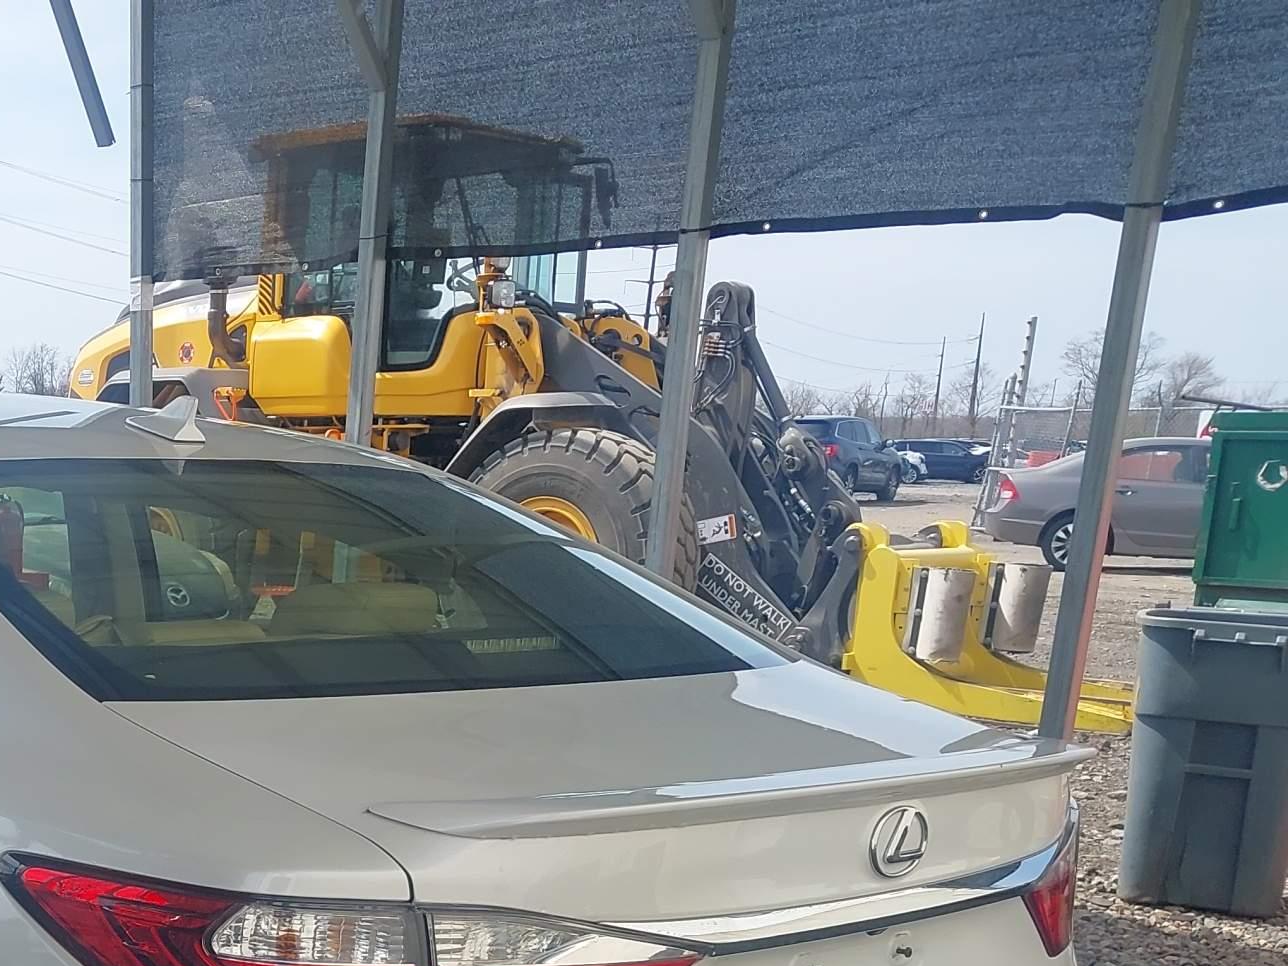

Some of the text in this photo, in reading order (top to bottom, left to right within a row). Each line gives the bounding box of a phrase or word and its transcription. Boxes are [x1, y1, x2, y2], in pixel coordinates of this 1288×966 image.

[701, 574, 775, 638] UNDER MAST
[703, 557, 787, 631] DO NOT WALK
